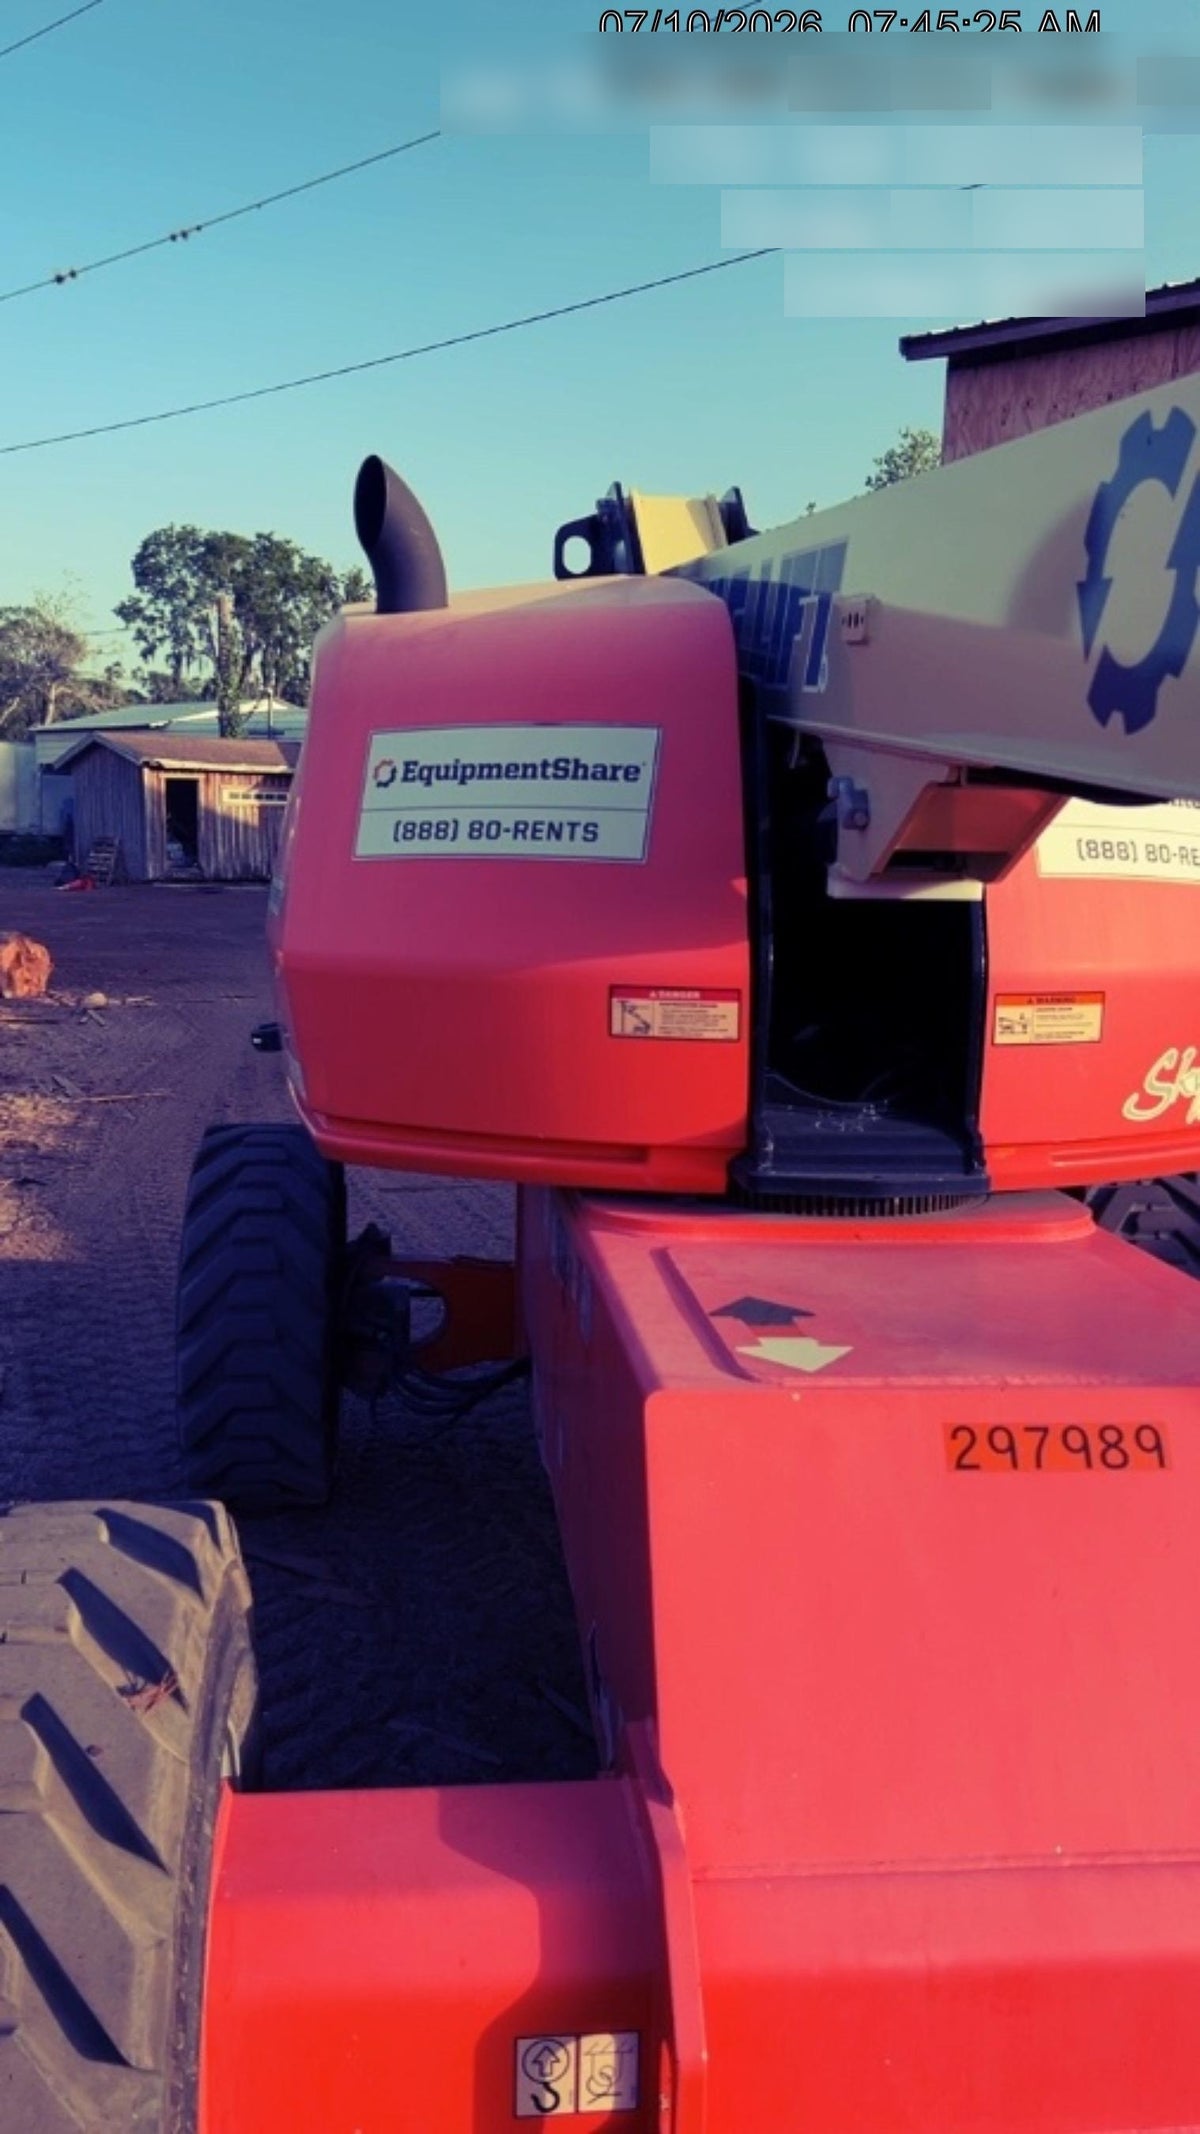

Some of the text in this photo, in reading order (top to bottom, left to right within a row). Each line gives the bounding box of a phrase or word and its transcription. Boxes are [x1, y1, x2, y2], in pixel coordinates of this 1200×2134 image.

[402, 758, 641, 787] EquipmentShare
[393, 819, 600, 843] (888) 80-RENTS
[1077, 838, 1137, 863] (888)
[950, 1424, 1165, 1470] 297989
